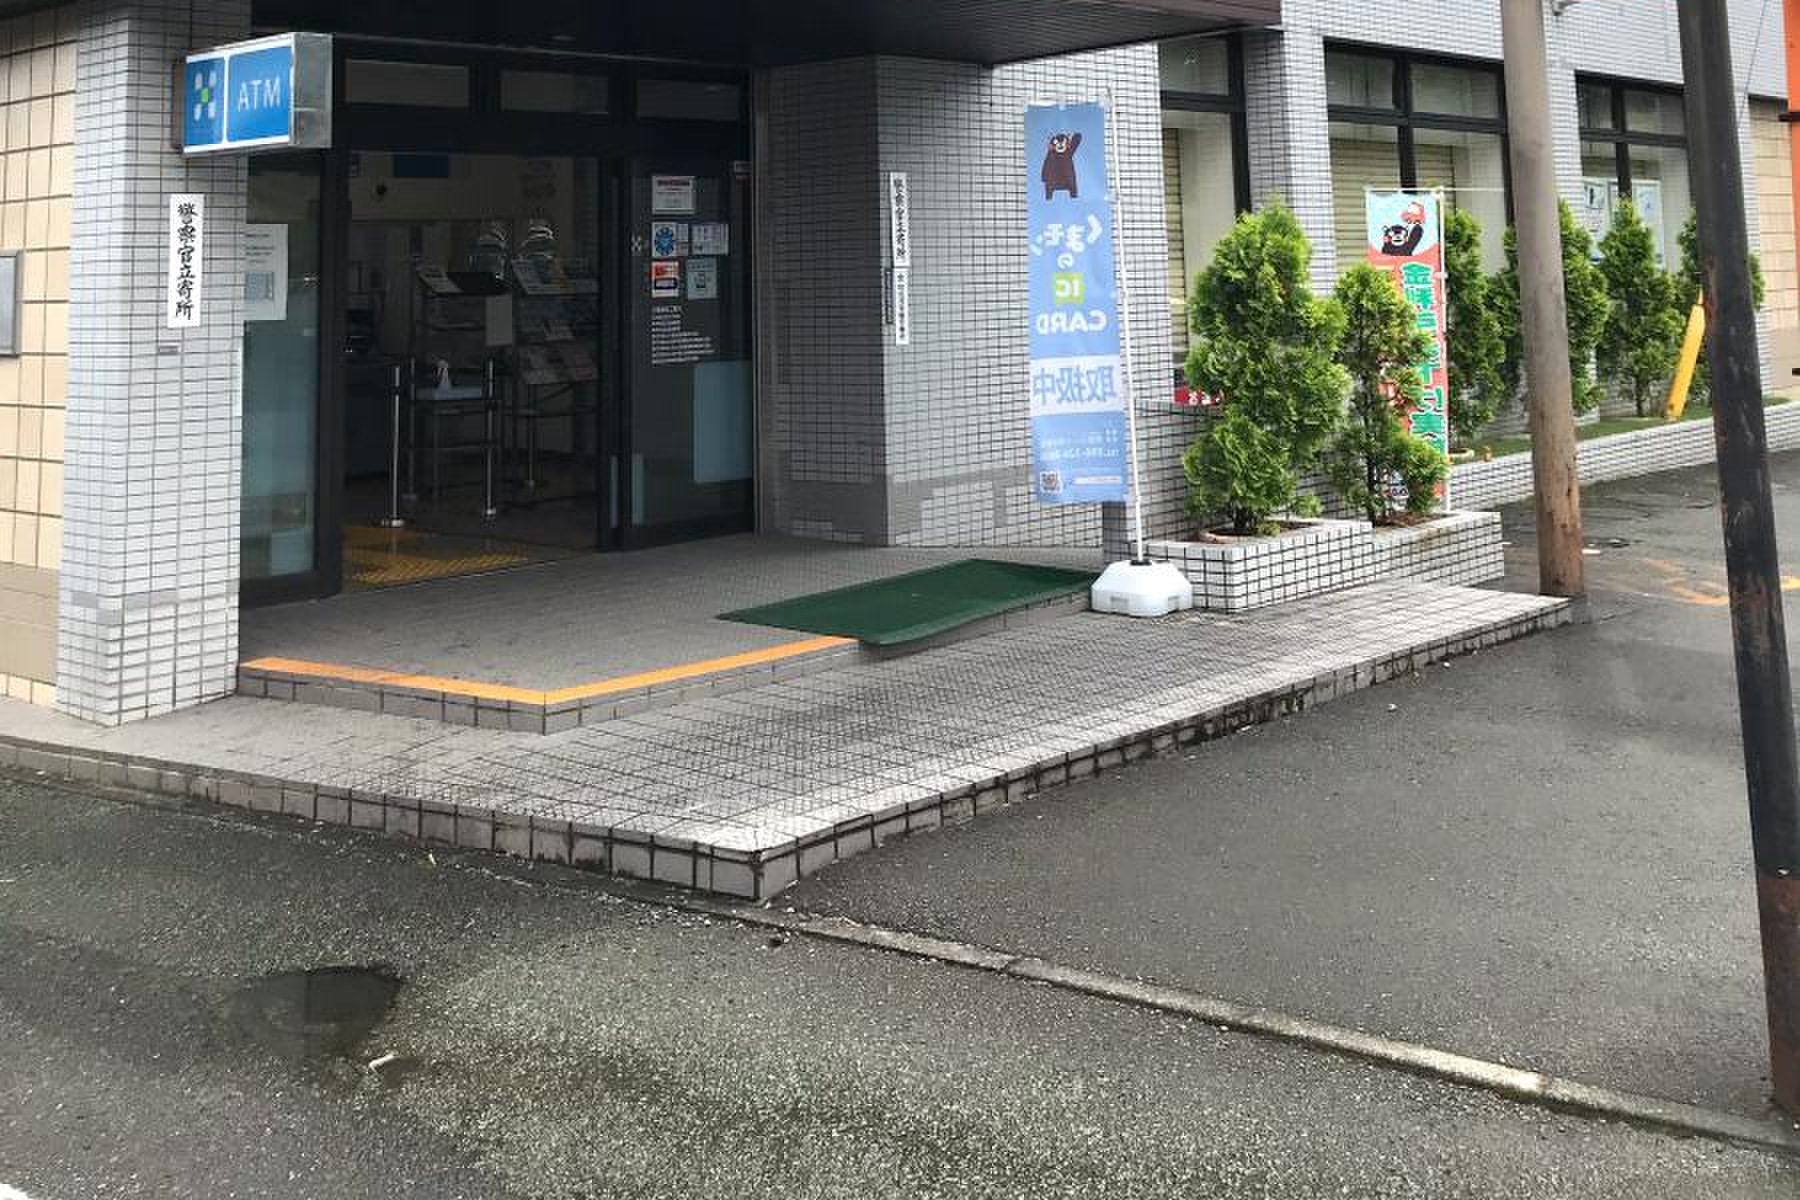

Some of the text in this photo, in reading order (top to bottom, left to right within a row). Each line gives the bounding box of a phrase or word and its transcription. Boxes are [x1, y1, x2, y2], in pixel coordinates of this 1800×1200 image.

[237, 77, 281, 112] ATM
[175, 202, 199, 321] 警察官立寄所
